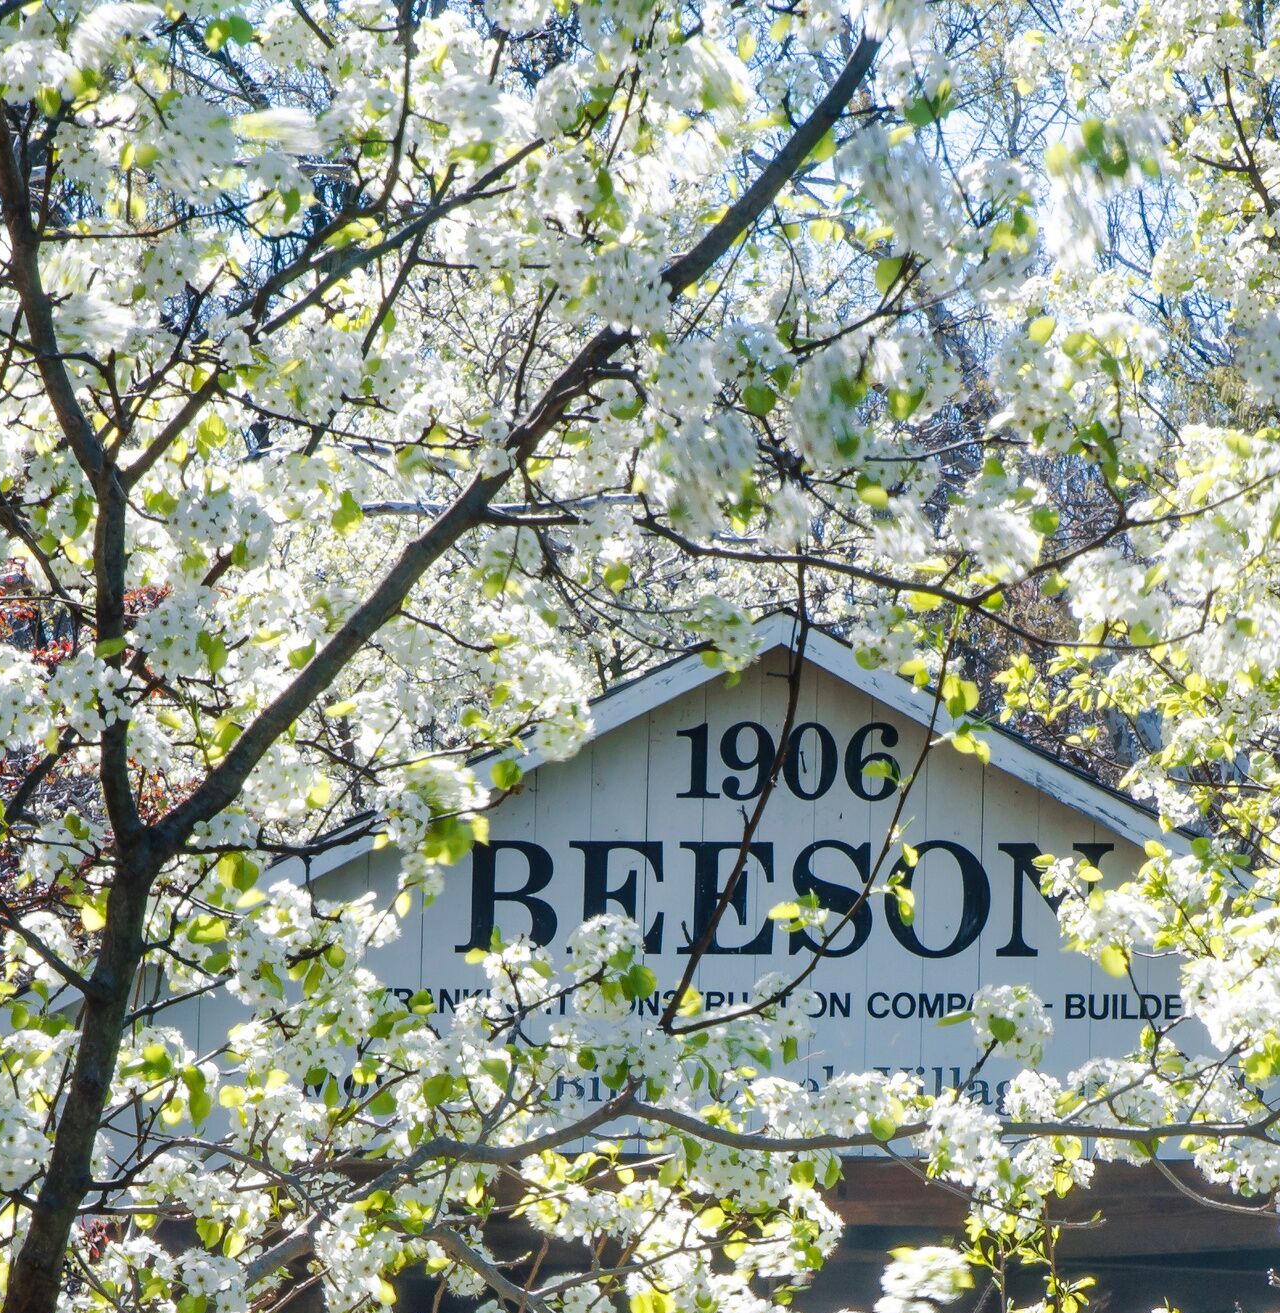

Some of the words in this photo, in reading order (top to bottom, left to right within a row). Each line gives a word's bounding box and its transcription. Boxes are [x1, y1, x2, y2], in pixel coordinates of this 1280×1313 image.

[675, 721, 901, 801] 1906
[454, 839, 1115, 958] BEESON
[1064, 993, 1182, 1019] BUILDE
